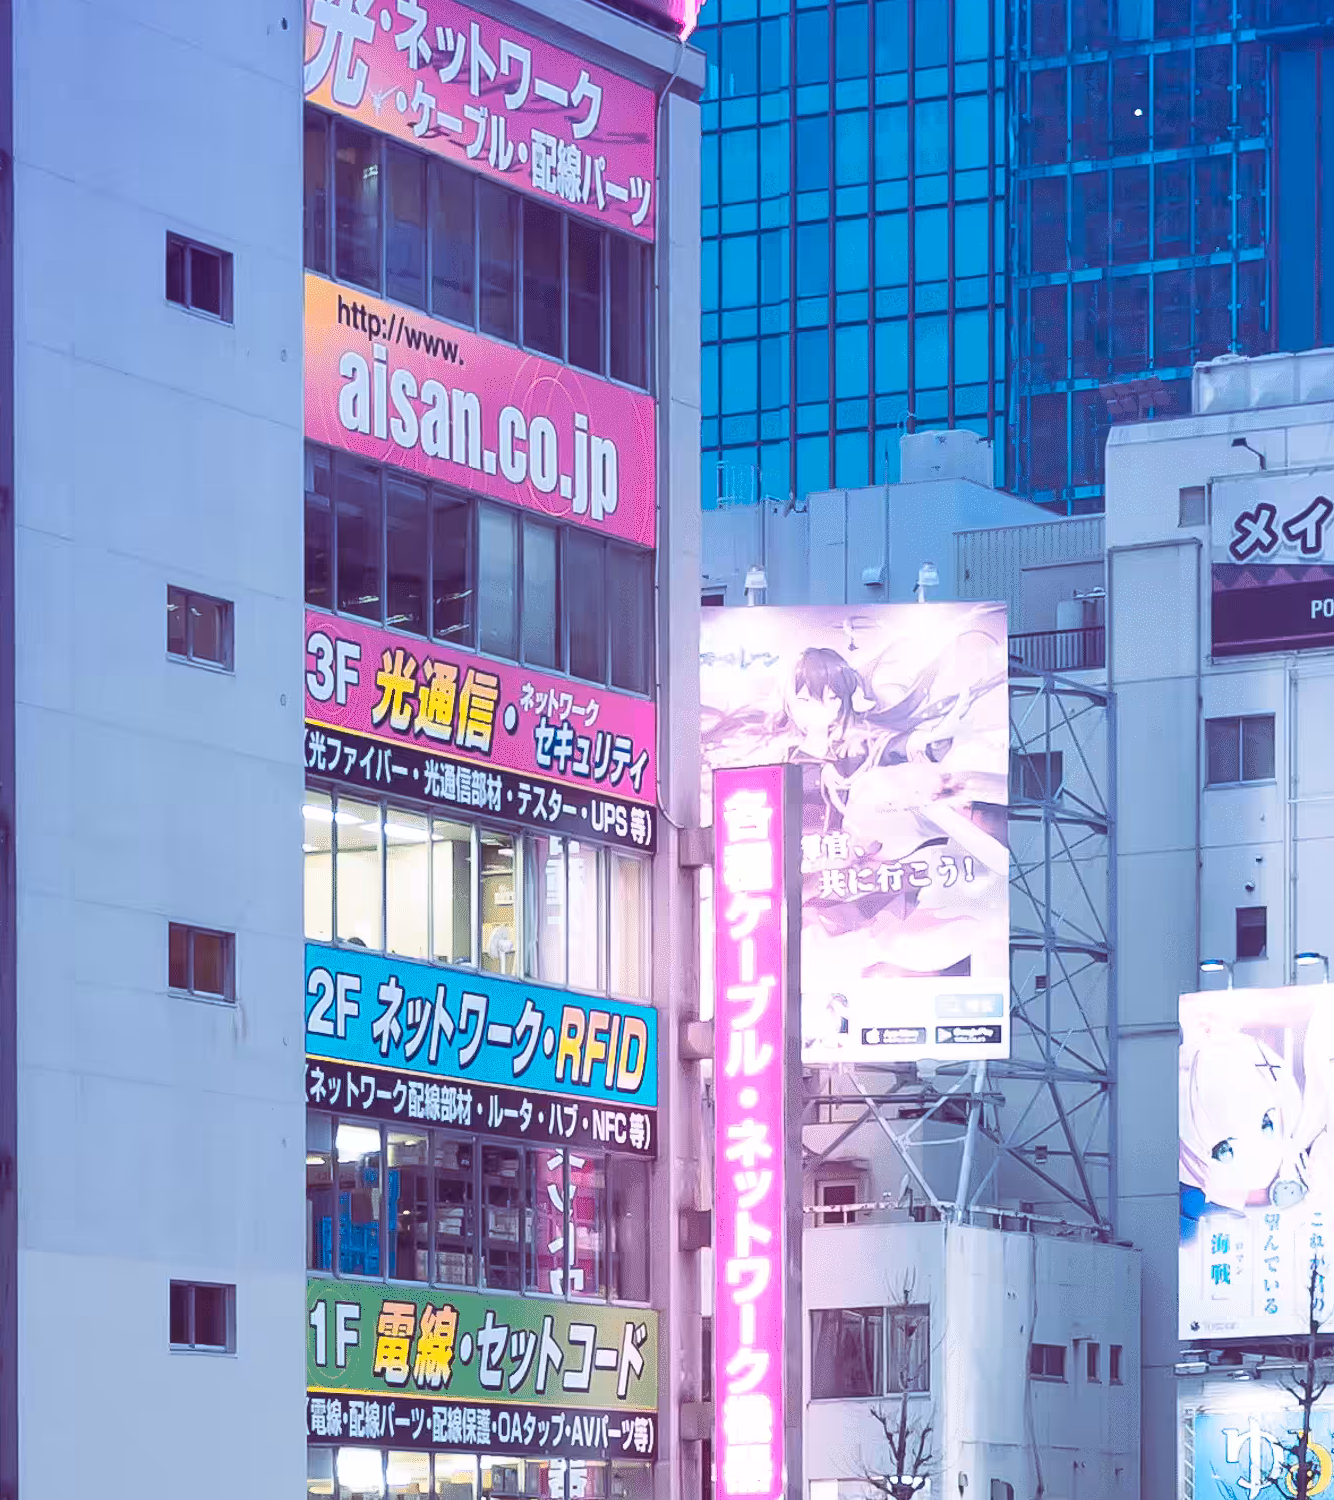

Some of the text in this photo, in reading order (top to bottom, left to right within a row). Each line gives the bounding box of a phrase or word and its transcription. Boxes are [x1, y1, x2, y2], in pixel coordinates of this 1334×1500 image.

[338, 295, 464, 366] http://www.
[338, 343, 618, 523] aisan.co.jp
[307, 631, 361, 706] 3F
[520, 683, 599, 727] ネットワーク
[535, 719, 649, 792] セキュリティ
[307, 969, 647, 1093] 2F ネットワーク・RFID
[309, 1300, 647, 1399] 1F 電線・セットコード
